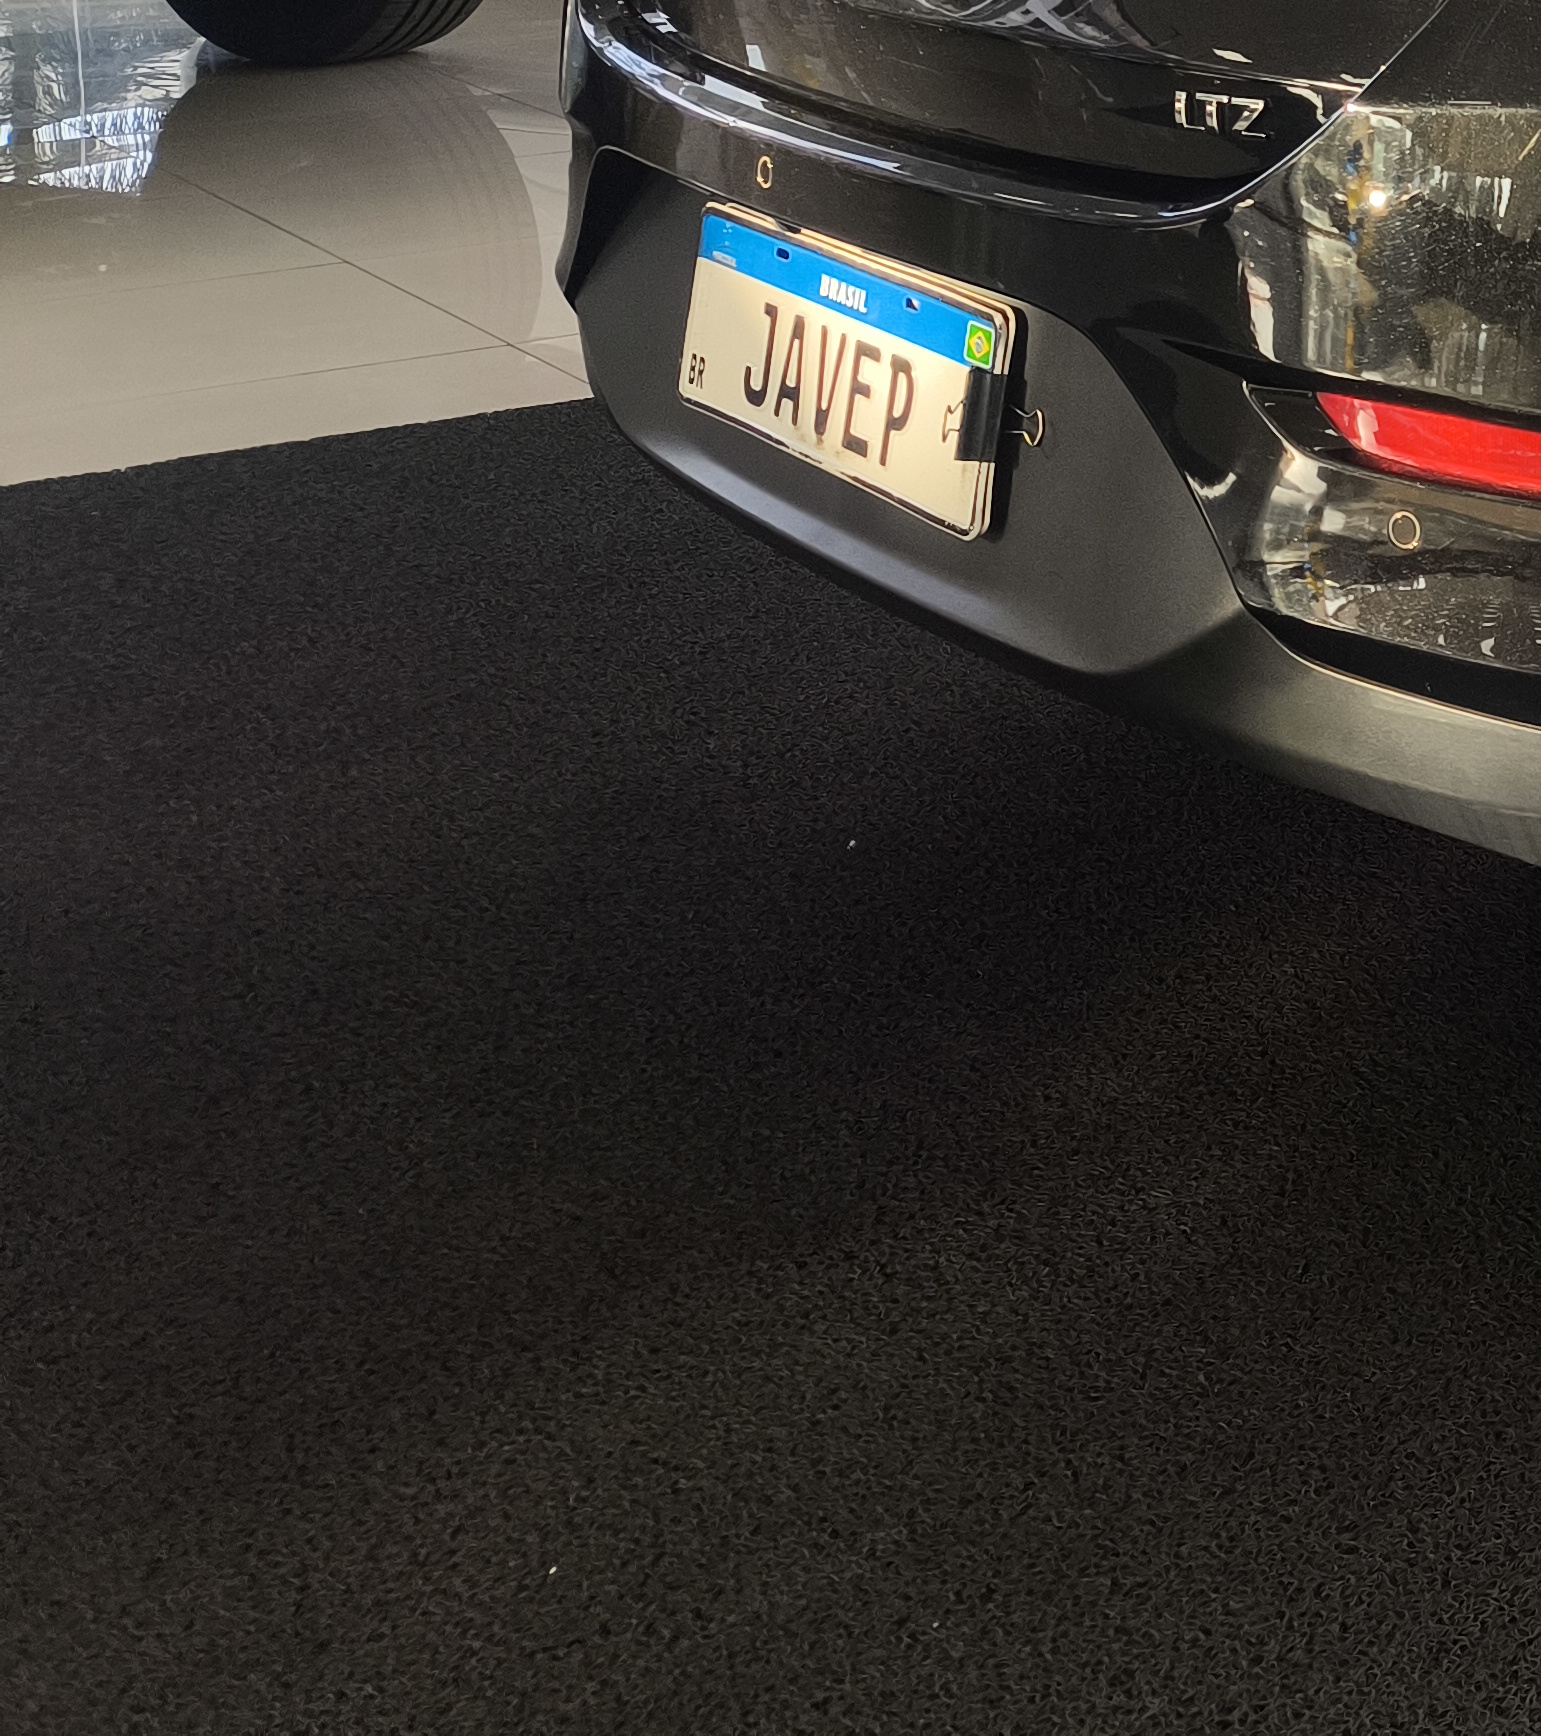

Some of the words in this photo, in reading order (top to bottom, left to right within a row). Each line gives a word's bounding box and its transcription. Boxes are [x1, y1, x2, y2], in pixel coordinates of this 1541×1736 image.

[1174, 90, 1266, 139] LTZ
[819, 273, 868, 314] BRASIL
[688, 352, 706, 390] BR
[744, 302, 915, 467] JAVEP
